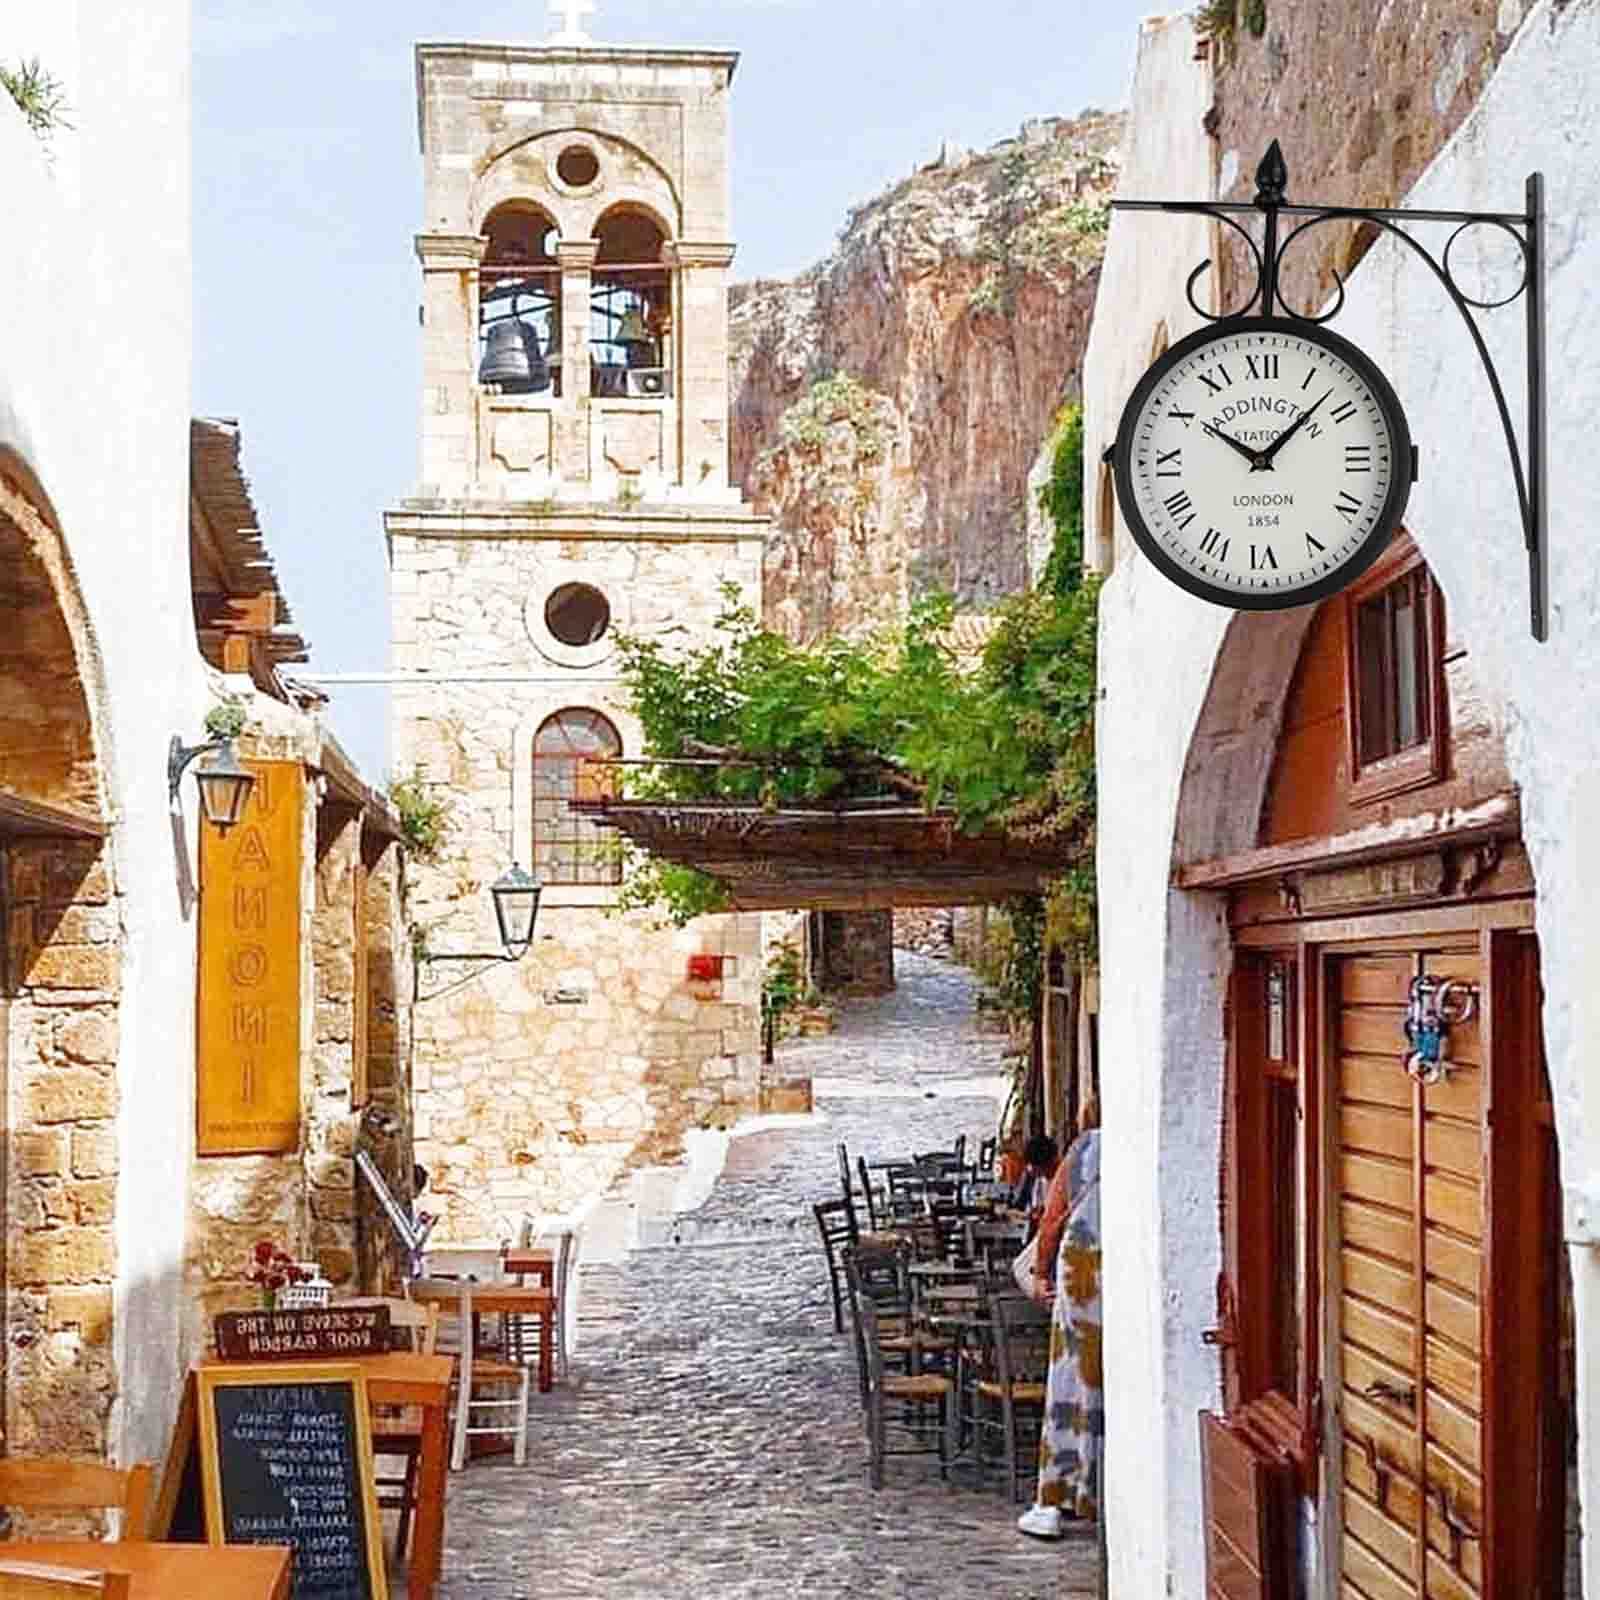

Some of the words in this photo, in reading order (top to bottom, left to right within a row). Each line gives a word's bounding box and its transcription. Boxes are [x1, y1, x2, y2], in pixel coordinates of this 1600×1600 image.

[1245, 354, 1279, 379] XII
[1198, 364, 1232, 397] XI
[1168, 403, 1196, 428] X
[1330, 401, 1358, 424] II
[1234, 430, 1286, 442] STATIO
[1156, 448, 1182, 477] IX
[1345, 445, 1371, 472] III
[1232, 494, 1294, 506] LONDON
[1334, 491, 1362, 524] IV
[1247, 515, 1280, 527] 1854
[1199, 527, 1230, 562] VII
[1250, 544, 1279, 569] VI
[1305, 532, 1326, 558] V
